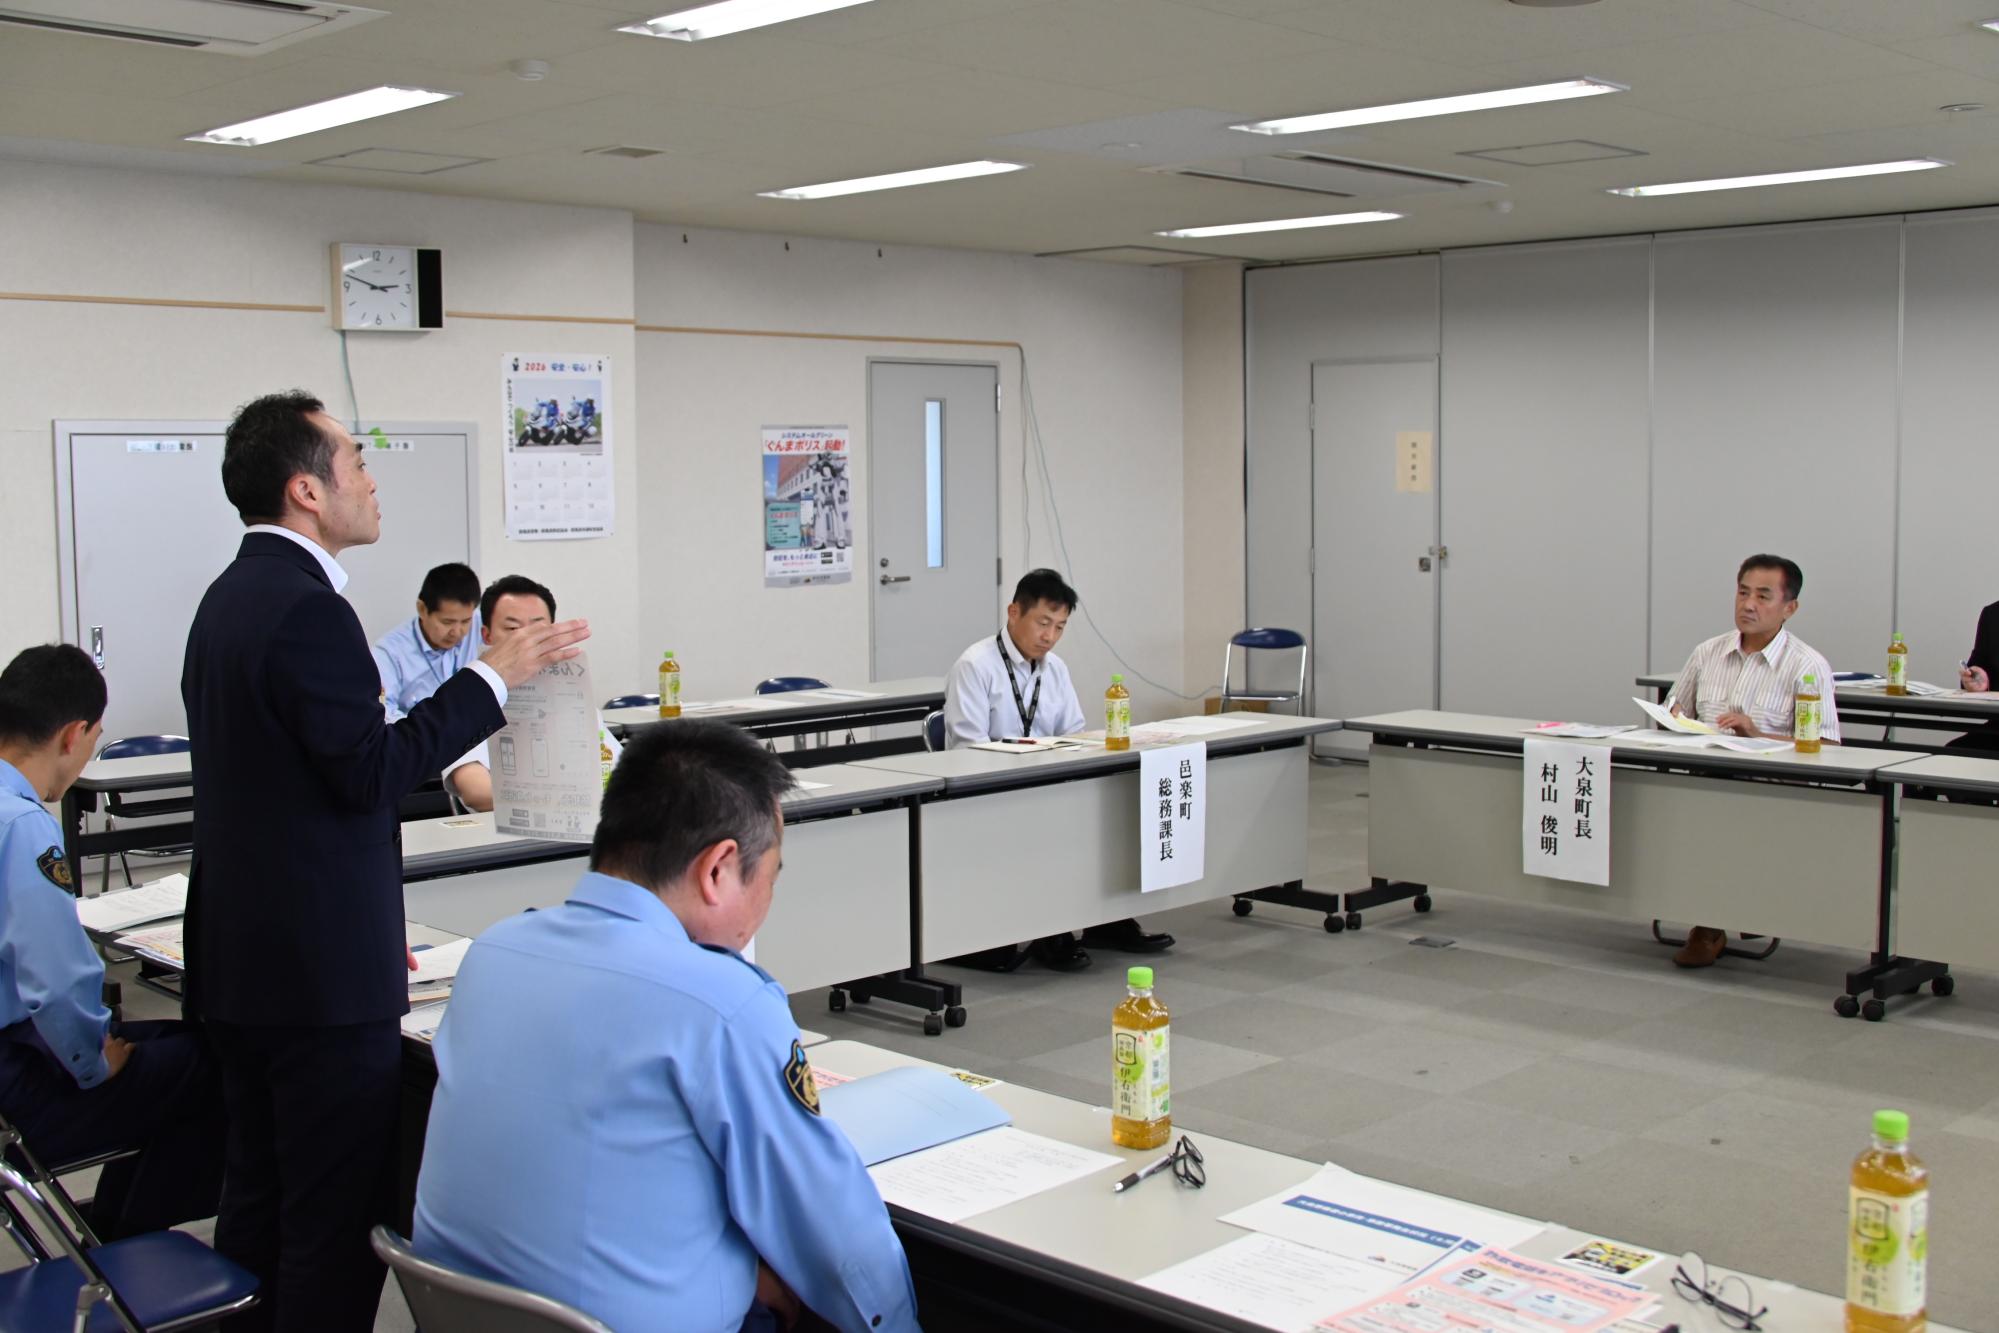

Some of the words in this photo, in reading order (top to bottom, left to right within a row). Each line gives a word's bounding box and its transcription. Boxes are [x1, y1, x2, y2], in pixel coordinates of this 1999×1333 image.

[372, 250, 381, 261] 12
[343, 281, 351, 292] 9
[405, 283, 412, 294] 3
[375, 314, 382, 325] 6
[524, 363, 546, 372] 2026
[1179, 759, 1192, 821] 邑楽町
[1541, 762, 1559, 804] 村山
[1574, 756, 1593, 840] 大泉町長
[1158, 778, 1173, 862] 総務課長
[1540, 814, 1558, 856] 俊明
[1120, 1066, 1131, 1117] 伊右衛門
